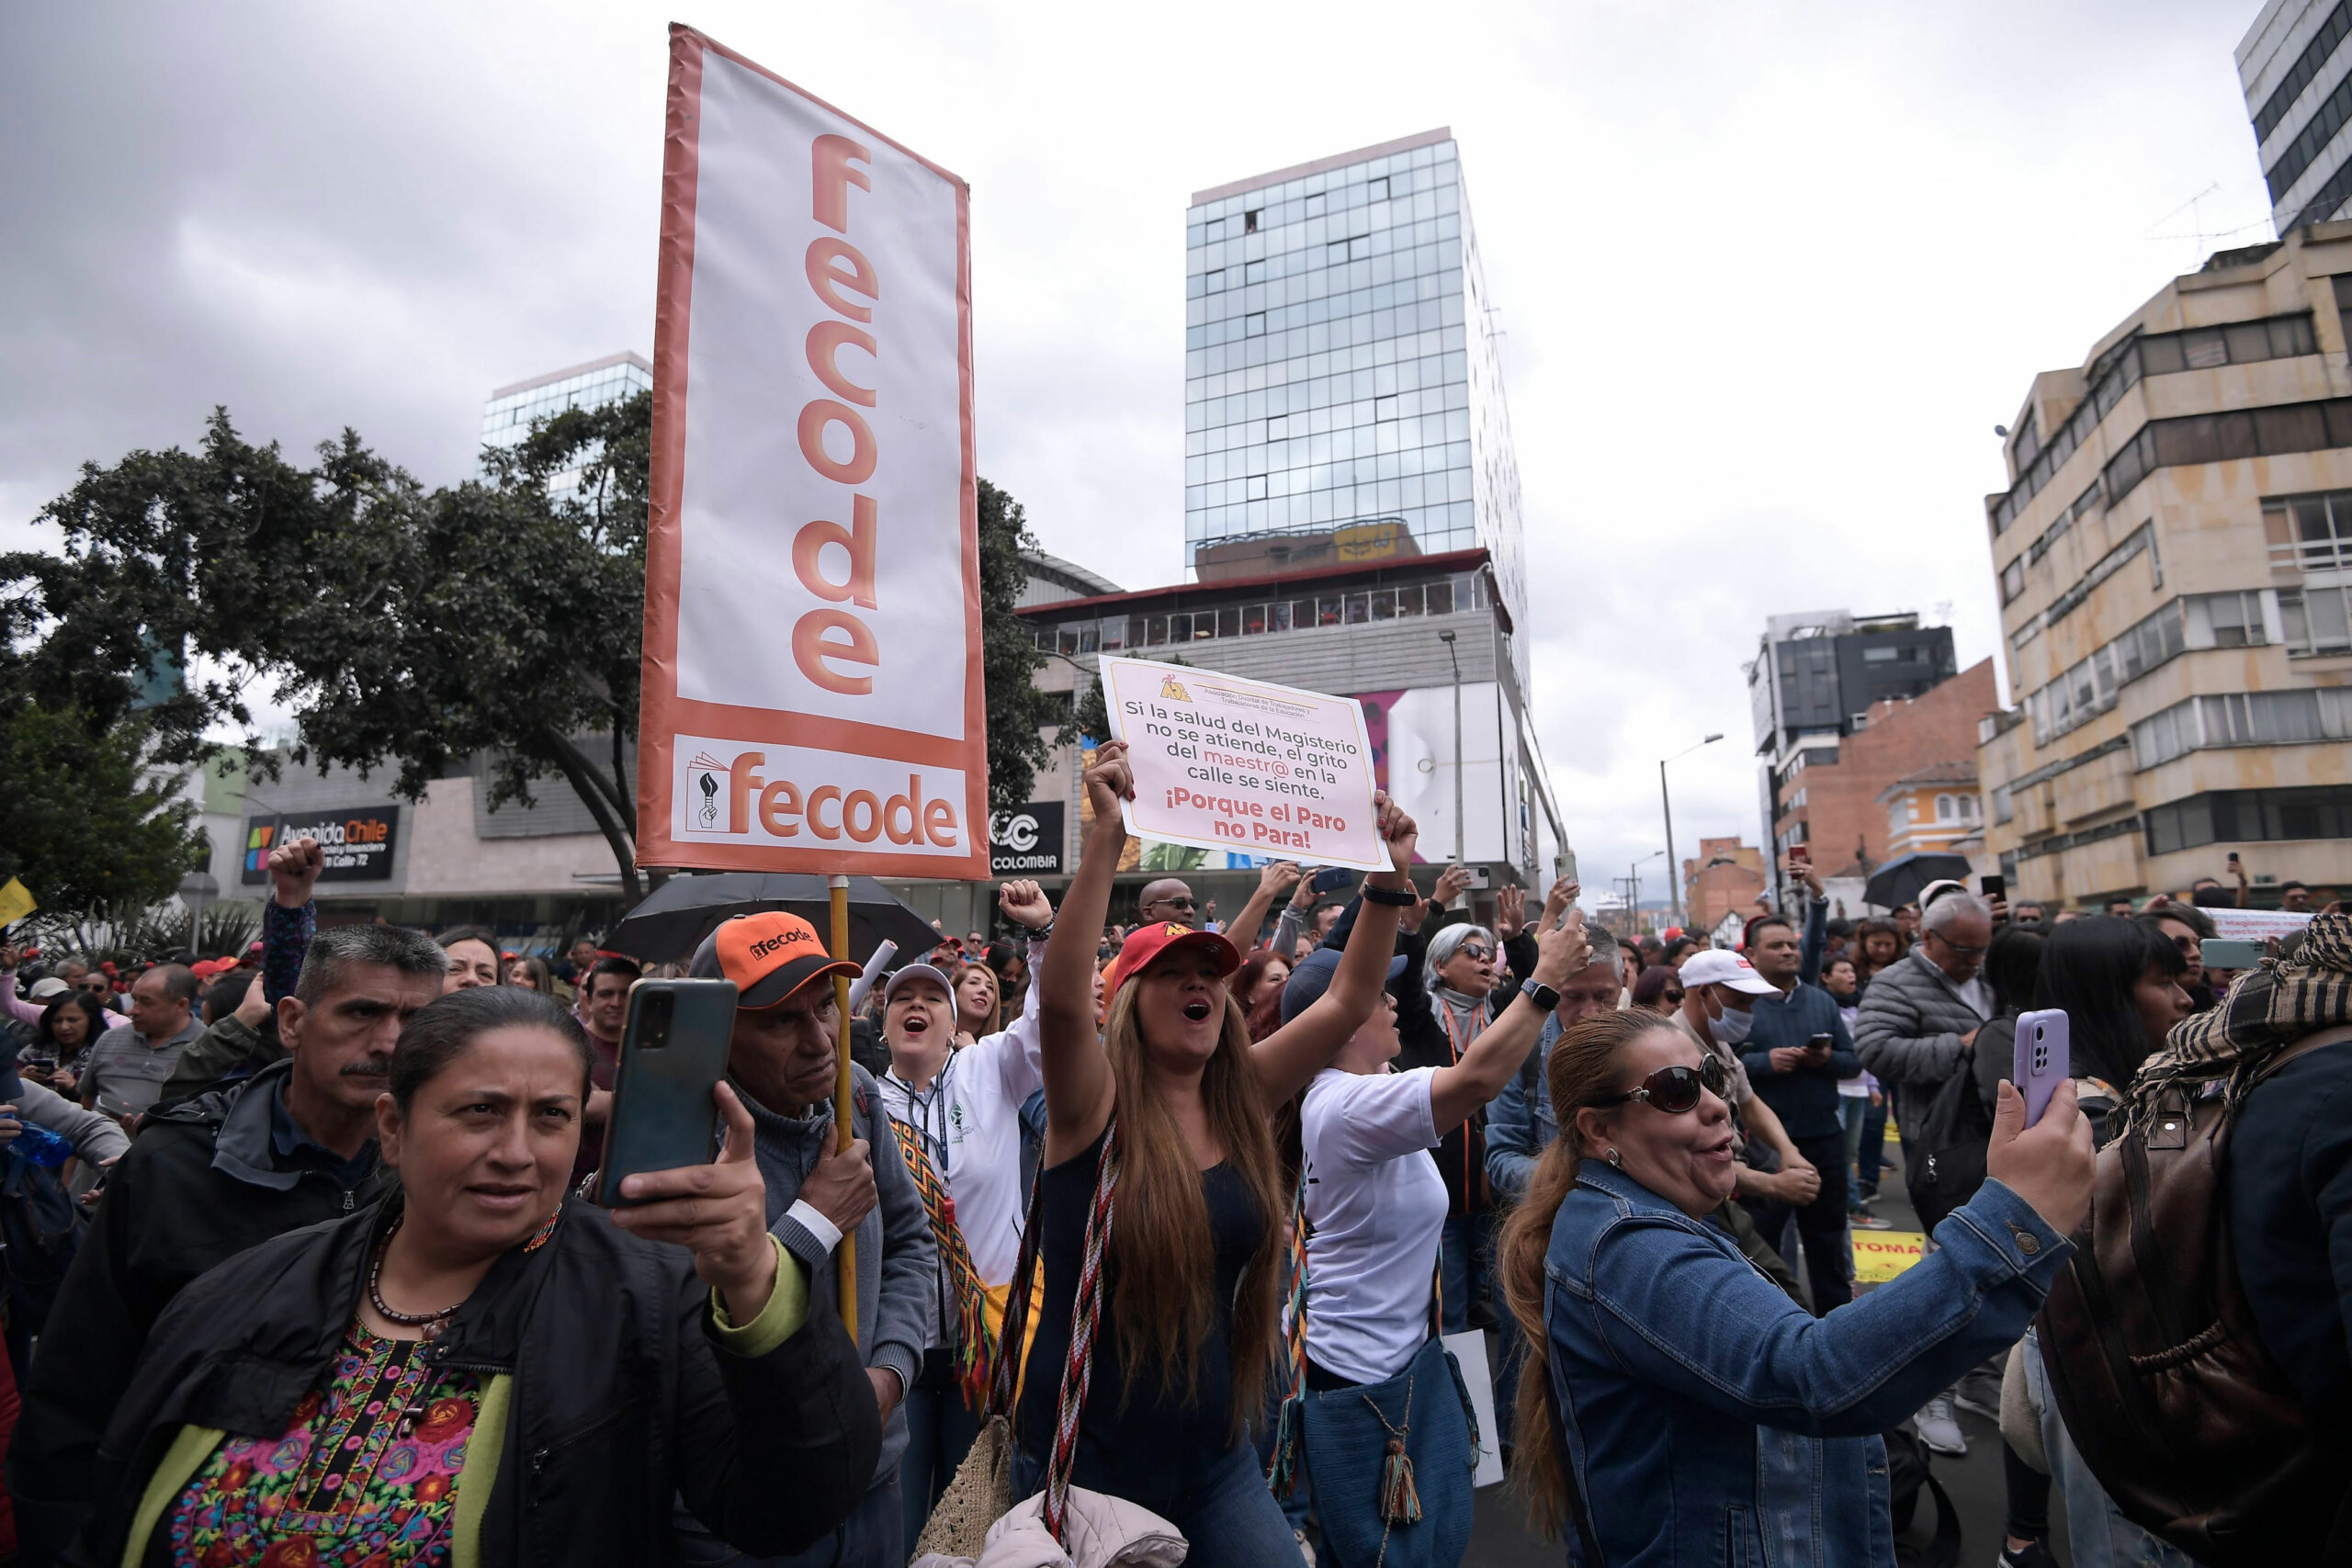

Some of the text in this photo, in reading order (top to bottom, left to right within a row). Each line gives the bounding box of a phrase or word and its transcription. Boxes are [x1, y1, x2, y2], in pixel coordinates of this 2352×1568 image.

[791, 133, 879, 696] fecode
[1125, 701, 1357, 754] Si la salud del Magisterio
[1146, 722, 1348, 769] no se atiende, el grito
[1167, 742, 1337, 784] del maestr@ en la
[1187, 766, 1325, 800] calle se siente.
[729, 751, 958, 848] fecode
[1166, 787, 1347, 832] ¡Porque el Paro
[1214, 820, 1311, 849] no Para!
[333, 855, 356, 868] Calle
[992, 855, 1057, 870] COLOMBIA
[757, 928, 814, 956] fecode
